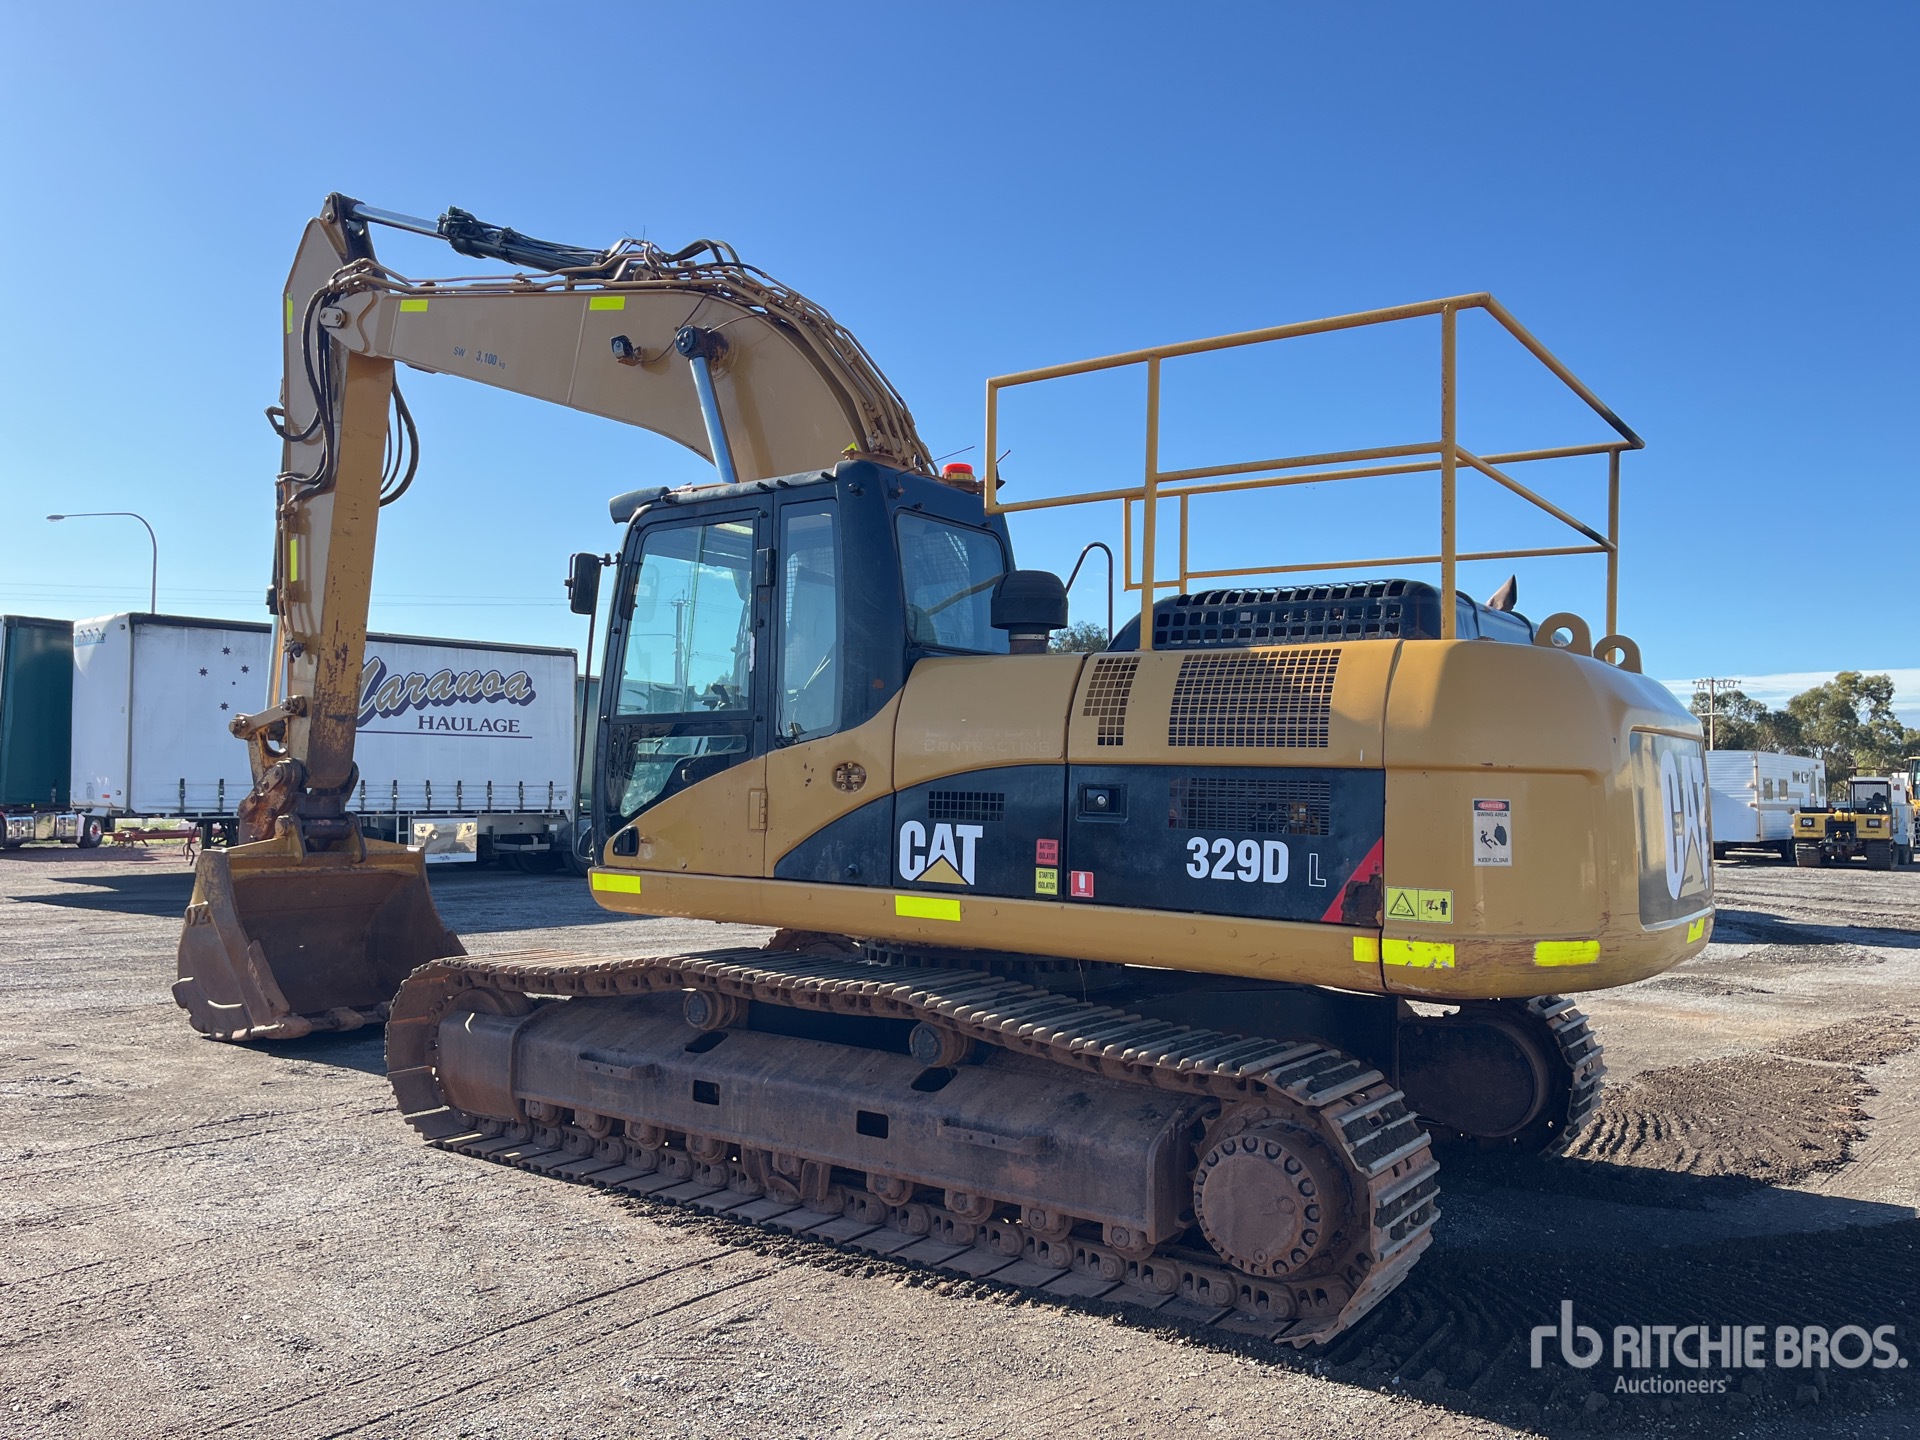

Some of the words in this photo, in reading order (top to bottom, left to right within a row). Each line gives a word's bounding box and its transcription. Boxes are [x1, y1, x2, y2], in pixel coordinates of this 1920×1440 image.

[476, 350, 498, 365] 3,100
[418, 715, 520, 733] HAULAGE
[1660, 749, 1709, 900] CAT
[899, 820, 983, 886] CAT
[1039, 842, 1056, 850] BATTERY
[1038, 852, 1056, 860] ISOLATOR
[1186, 836, 1289, 884] 329D
[1308, 853, 1327, 887] L
[1038, 871, 1055, 879] STARTER
[1038, 881, 1056, 889] ISOLATOR
